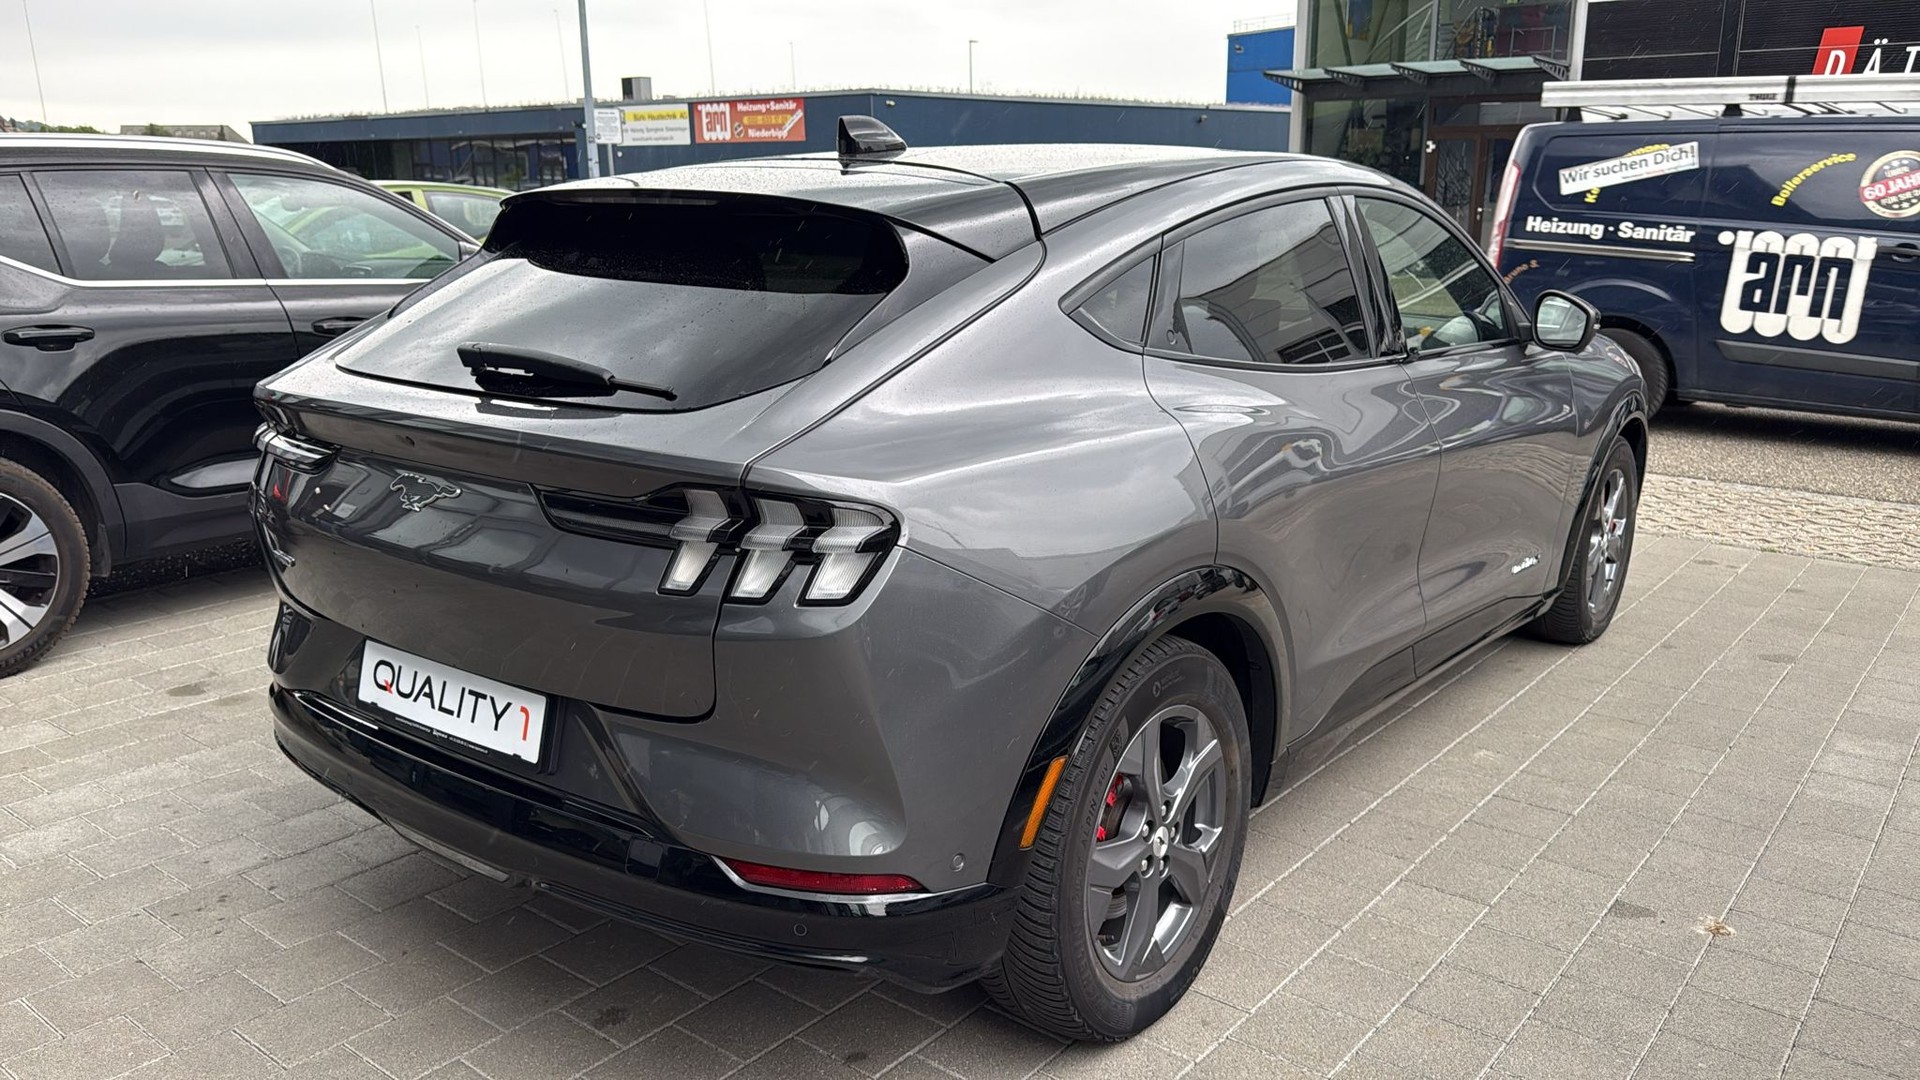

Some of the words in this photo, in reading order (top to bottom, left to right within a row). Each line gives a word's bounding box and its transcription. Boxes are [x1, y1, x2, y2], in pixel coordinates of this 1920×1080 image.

[737, 102, 766, 113] Heizung
[770, 101, 797, 111] Sanitär
[748, 128, 788, 139] Niederbipp
[1562, 169, 1588, 184] Wir
[1594, 159, 1649, 178] suchen
[1653, 145, 1695, 165] Dich!
[1863, 184, 1887, 200] 60
[1525, 216, 1605, 239] Heizung
[1617, 221, 1696, 243] Sanitär
[373, 659, 512, 732] QUALITY
